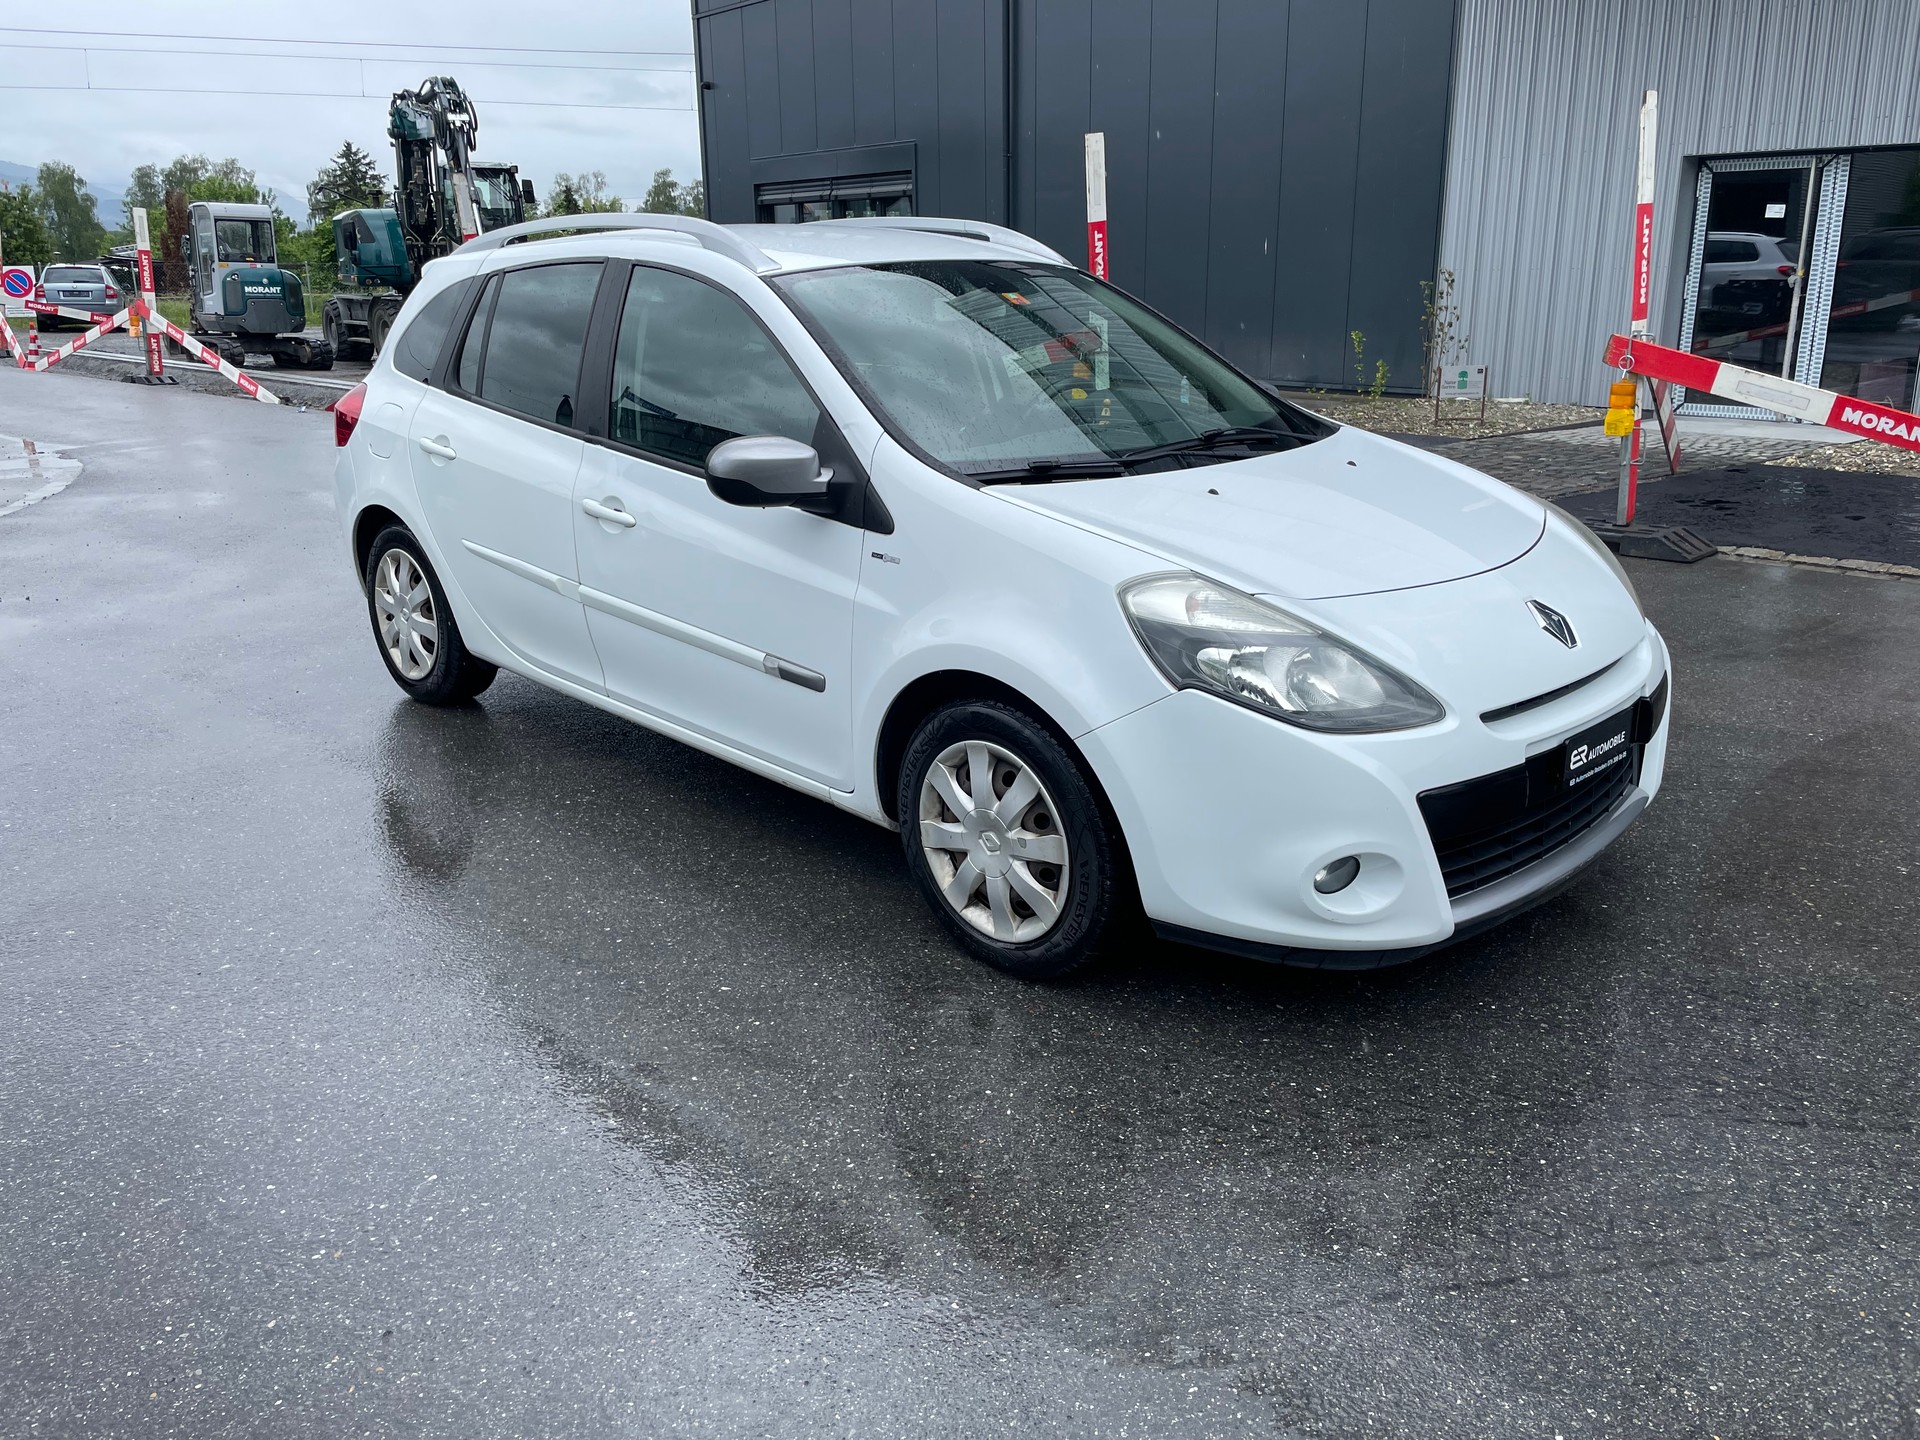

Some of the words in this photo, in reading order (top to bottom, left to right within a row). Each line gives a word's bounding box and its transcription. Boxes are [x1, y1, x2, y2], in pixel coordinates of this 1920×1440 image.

[142, 254, 152, 289] MORANT
[1094, 230, 1104, 279] RANT
[1640, 214, 1650, 304] MORANT
[28, 303, 56, 312] MORANT
[244, 286, 282, 294] MORANT
[167, 326, 183, 341] MORANT
[150, 337, 160, 372] MORANT
[202, 350, 219, 367] MORANT
[239, 377, 257, 393] MORANT
[1840, 406, 1920, 444] MORAN
[1570, 744, 1588, 770] ER
[1588, 730, 1626, 761] AUTOMOBILE
[900, 746, 924, 827] VREDESTEIN
